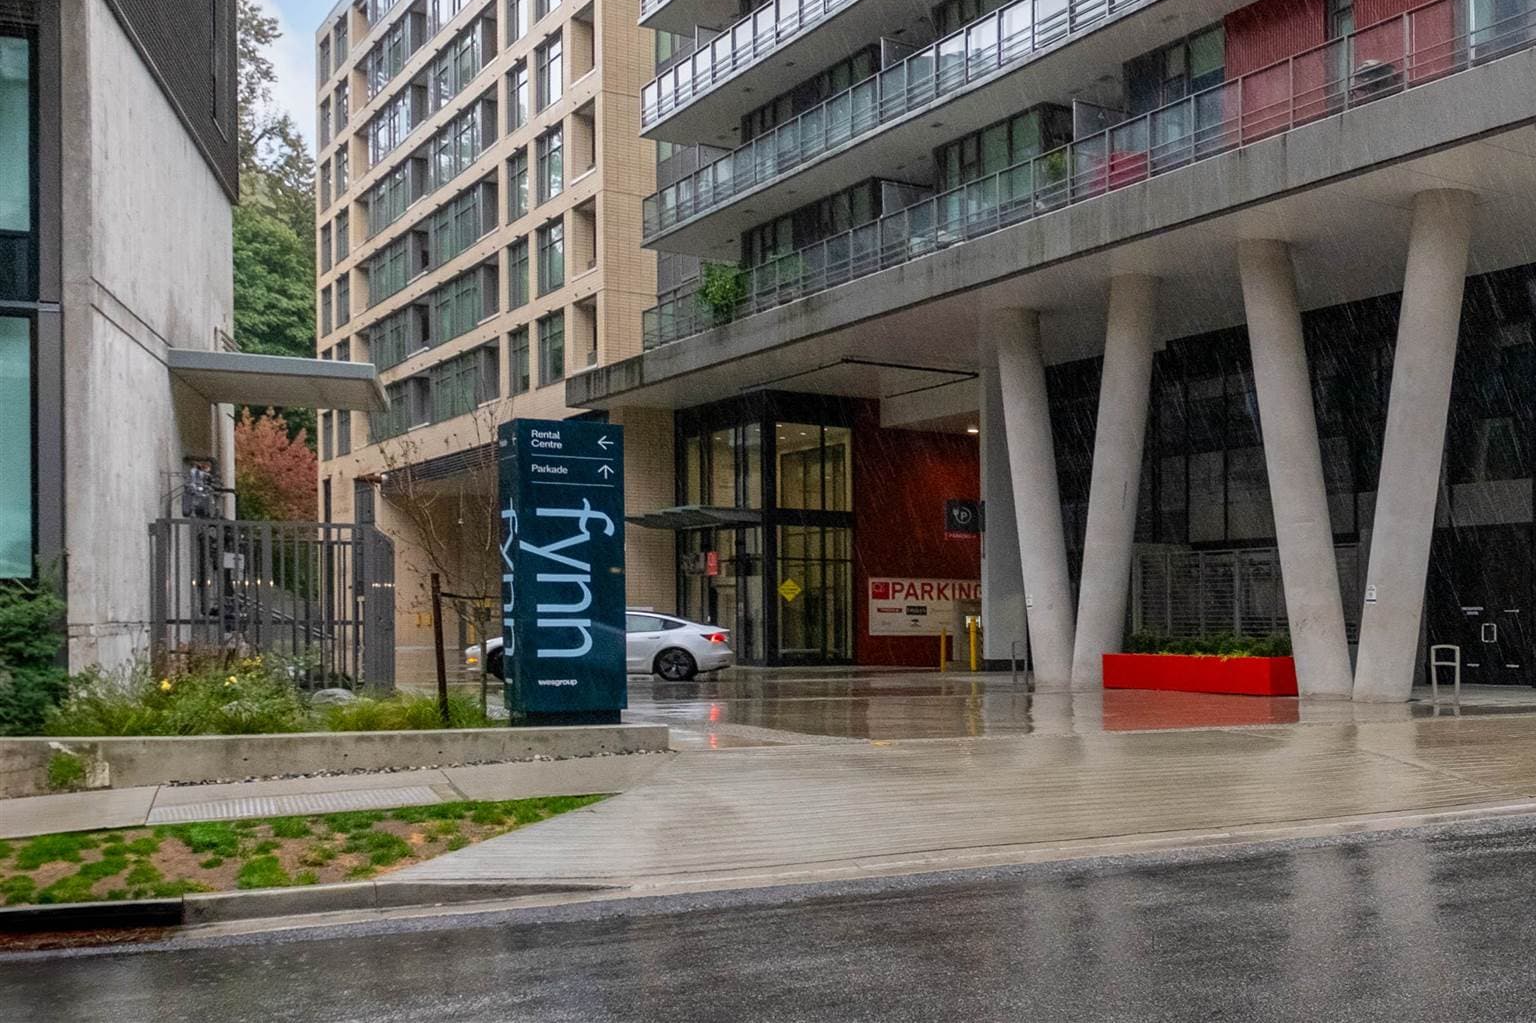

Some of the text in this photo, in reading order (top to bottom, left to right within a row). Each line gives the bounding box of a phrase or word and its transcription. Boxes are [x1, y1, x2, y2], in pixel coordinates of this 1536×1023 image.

[531, 429, 561, 439] Rental
[531, 439, 563, 450] Centre
[531, 464, 569, 474] Parkade
[520, 497, 615, 658] fynn
[537, 678, 578, 687] wesgroup
